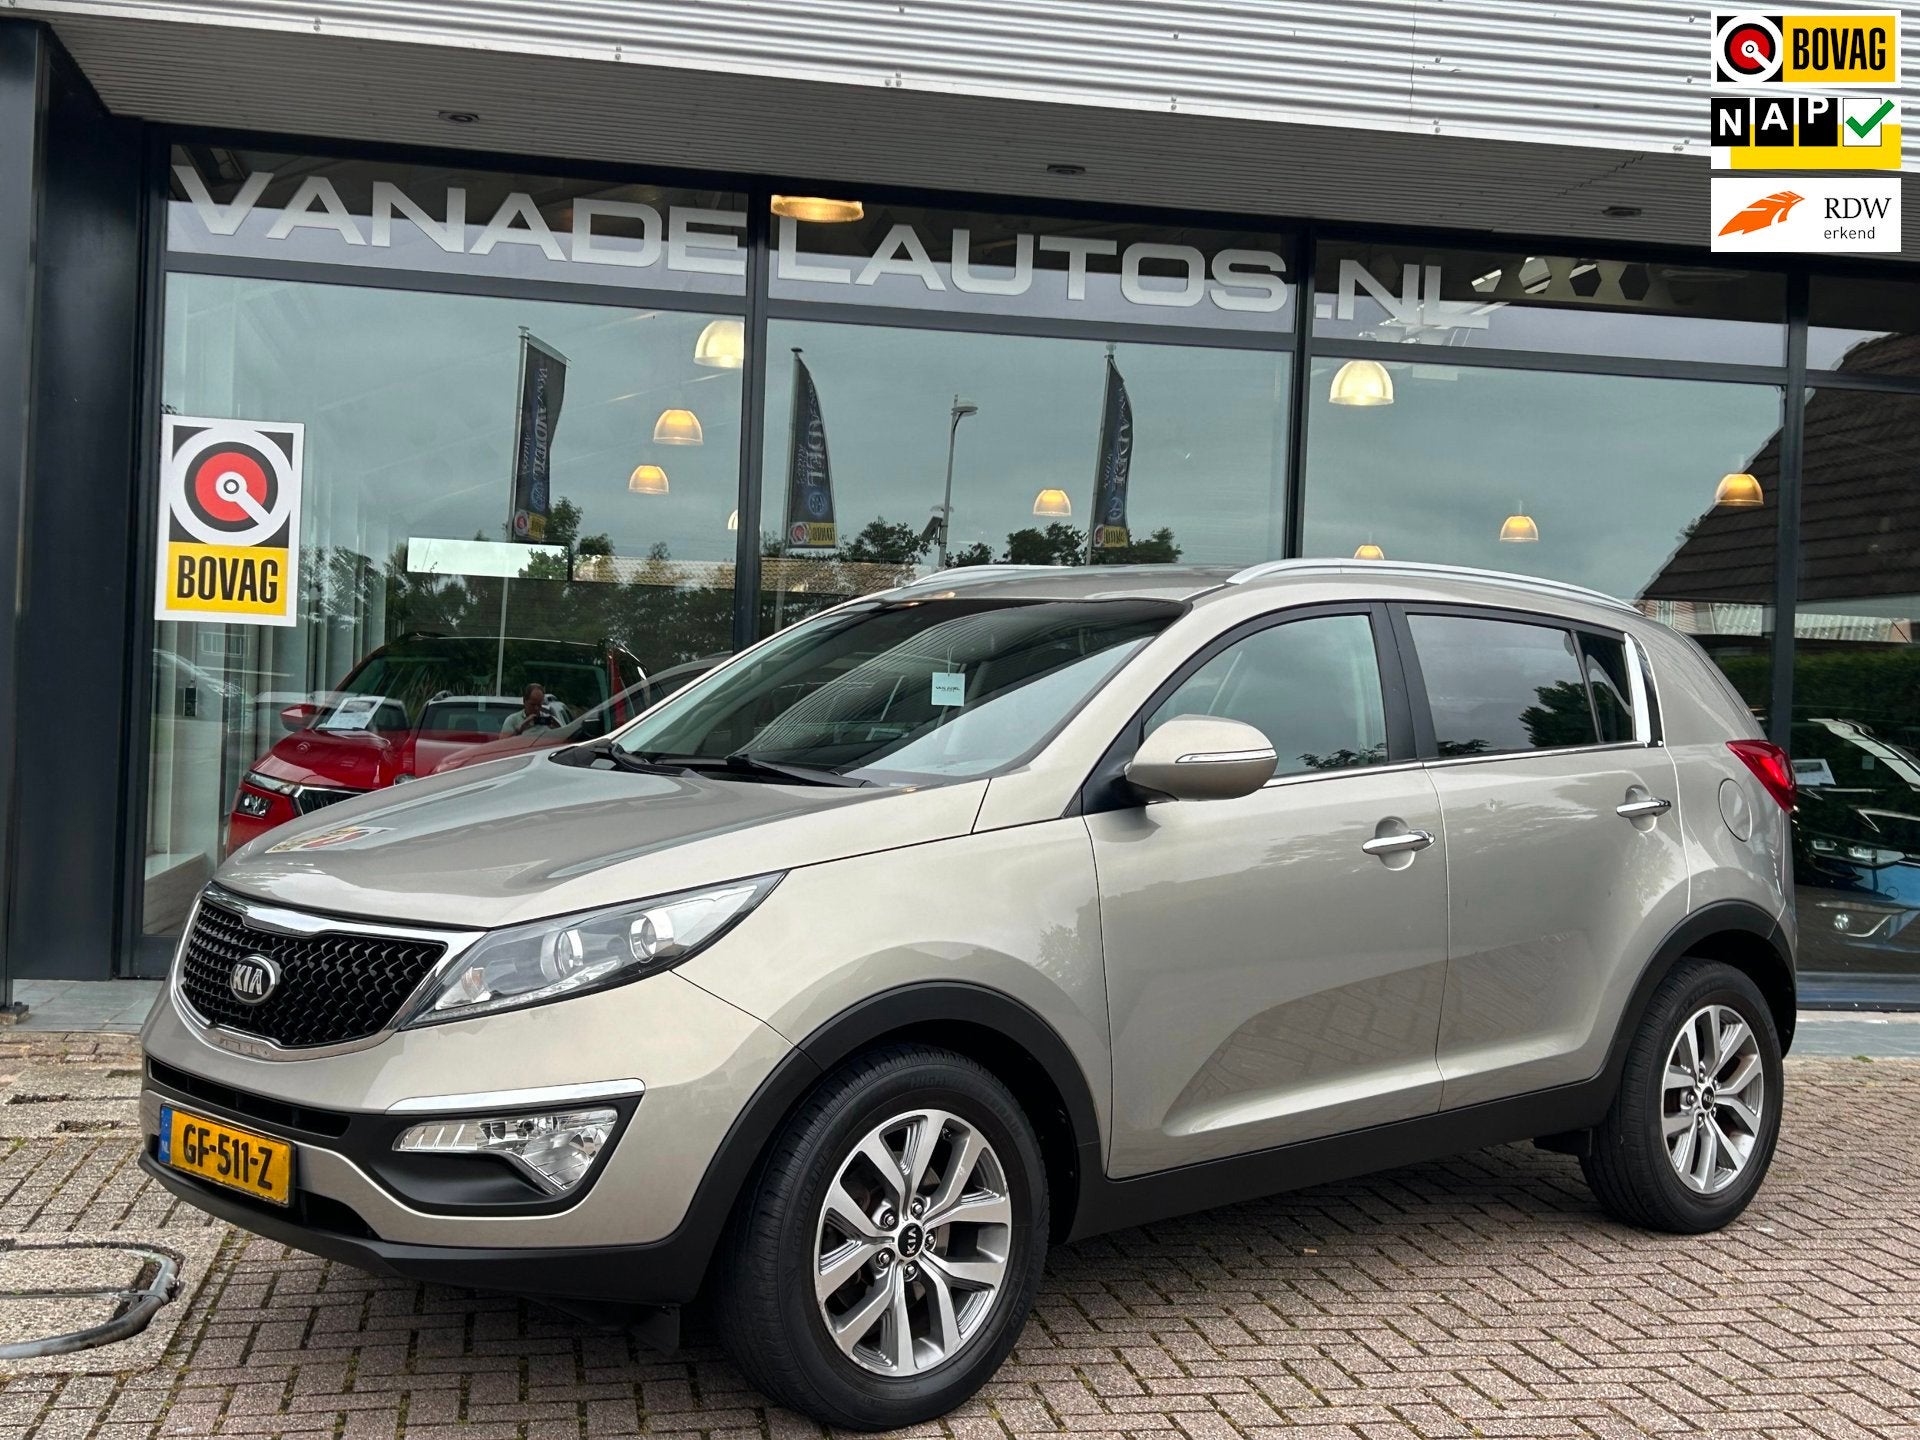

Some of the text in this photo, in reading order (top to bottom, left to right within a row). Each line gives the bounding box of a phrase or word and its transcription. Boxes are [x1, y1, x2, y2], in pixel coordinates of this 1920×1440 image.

[177, 554, 279, 604] BOVAG
[233, 963, 263, 995] KIA
[183, 1123, 273, 1191] GF-511-Z
[906, 1226, 918, 1254] KIA
